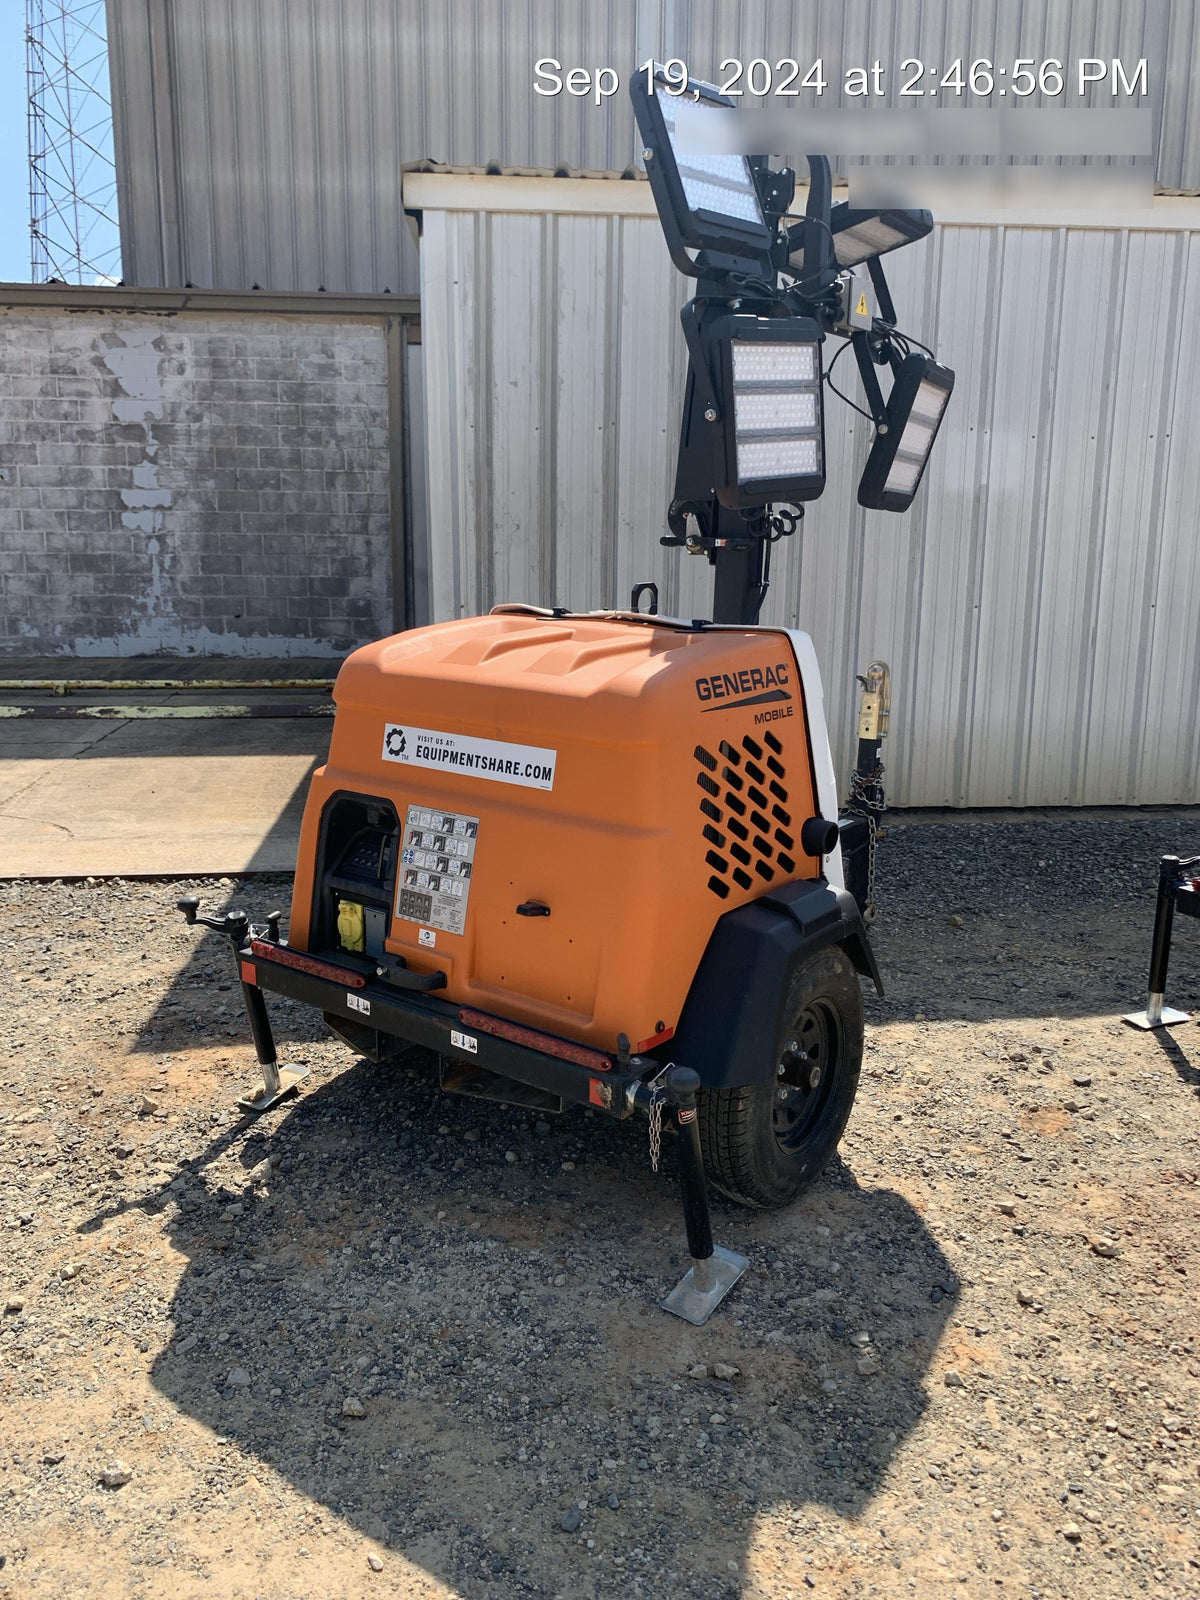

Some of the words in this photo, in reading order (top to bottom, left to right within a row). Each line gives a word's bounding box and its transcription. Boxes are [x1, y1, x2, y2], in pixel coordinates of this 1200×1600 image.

[695, 664, 789, 701] GENERAC
[754, 706, 793, 725] MOBILE
[417, 735, 434, 744] VISIT
[415, 745, 553, 782] EQUIPMENTSHARE.COM
